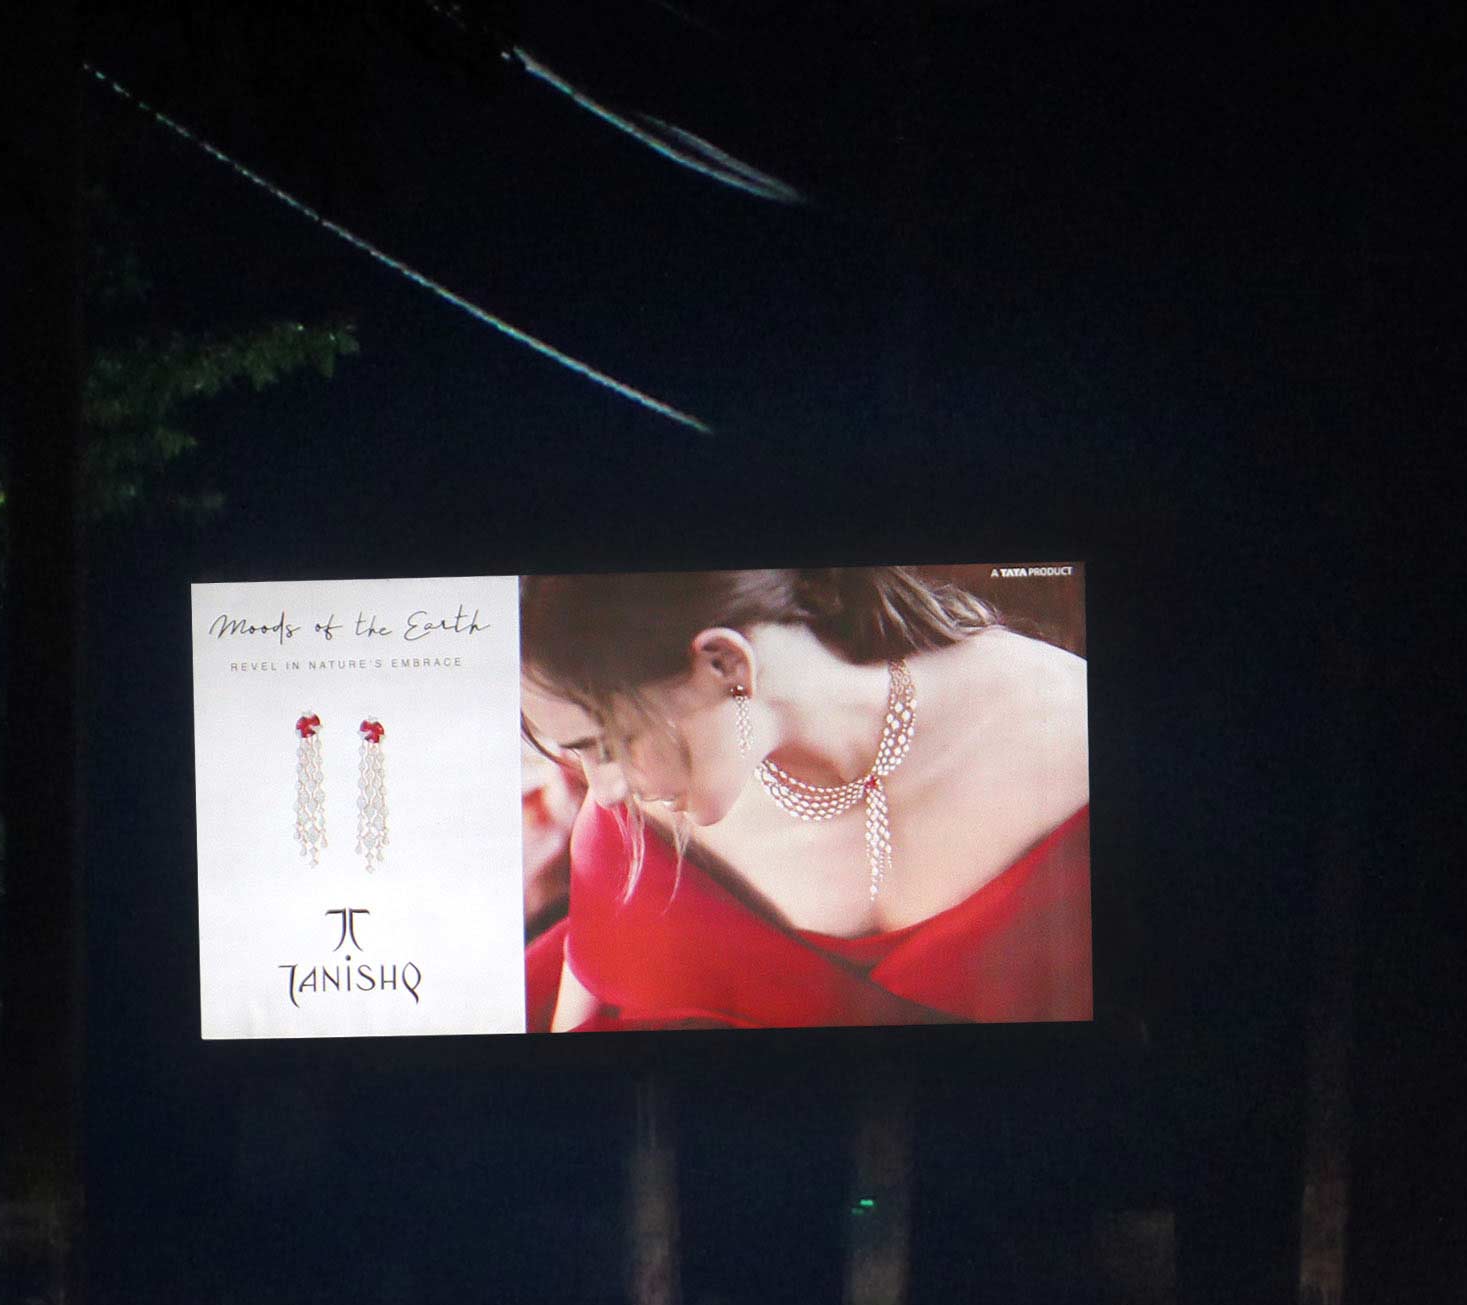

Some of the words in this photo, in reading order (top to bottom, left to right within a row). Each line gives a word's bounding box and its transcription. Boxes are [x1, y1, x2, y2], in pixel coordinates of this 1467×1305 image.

[990, 569, 1000, 577] A
[1000, 567, 1027, 577] TATA
[1028, 567, 1073, 576] PRODUCT
[209, 611, 301, 645] Moods
[315, 614, 343, 640] of
[355, 611, 393, 637] the
[404, 604, 491, 641] Earth
[230, 662, 277, 672] REVEL
[285, 661, 300, 670] IN
[308, 659, 383, 670] NATURE'S
[391, 657, 463, 668] EMBRACE
